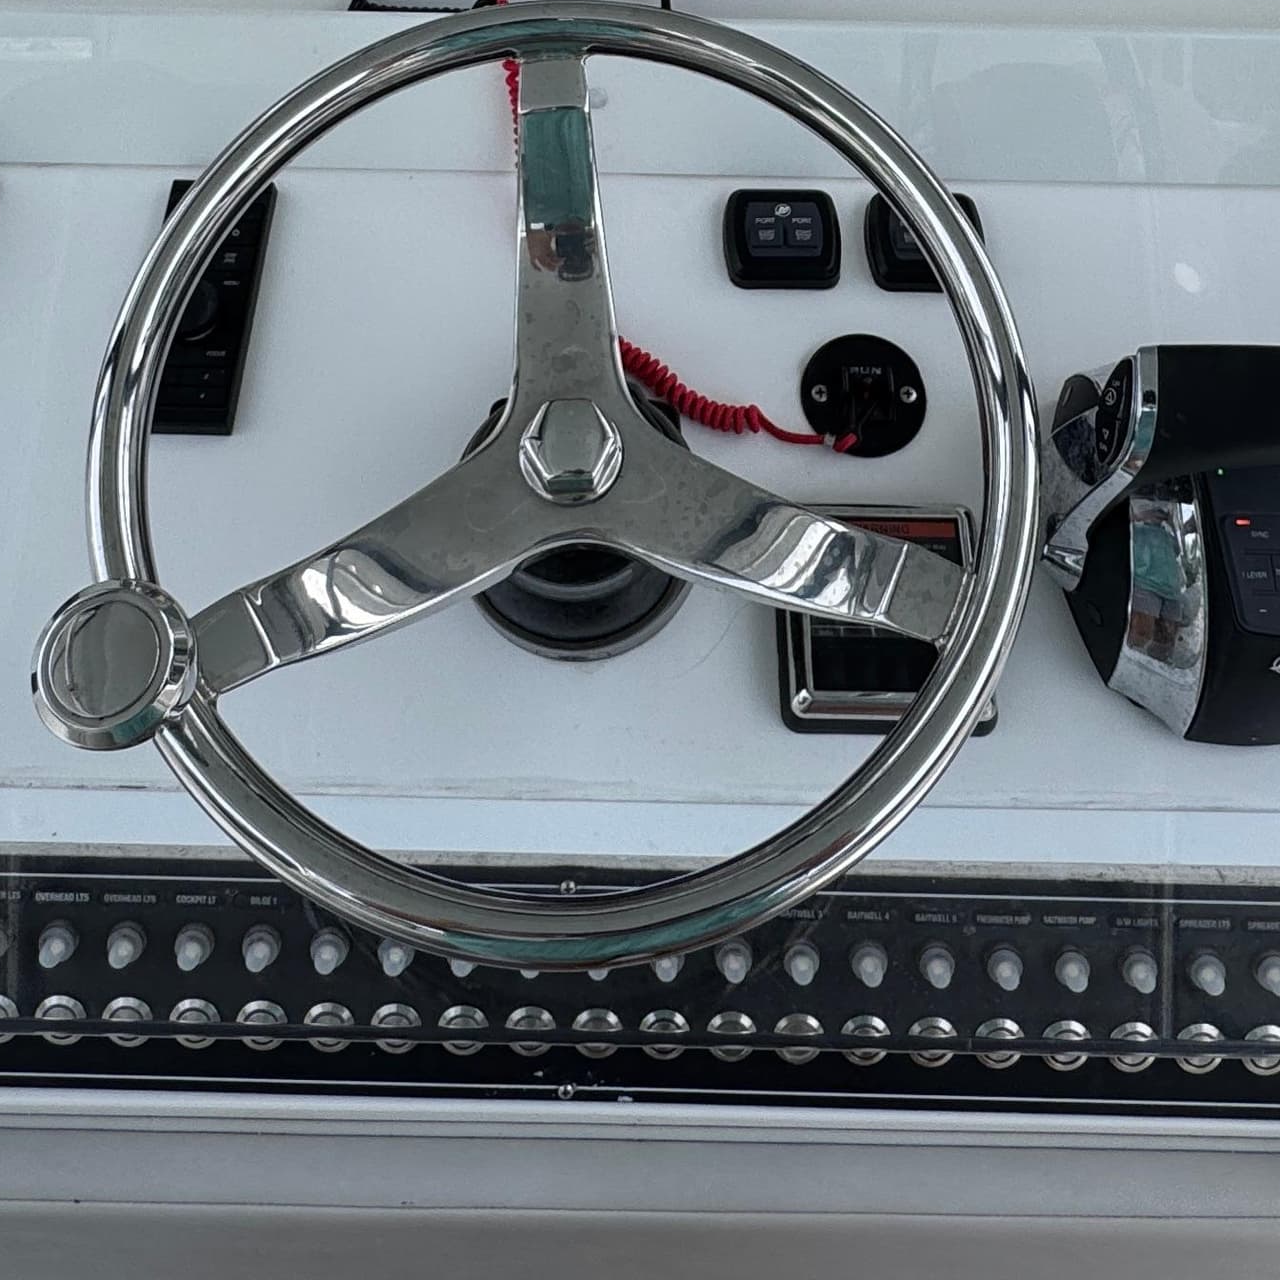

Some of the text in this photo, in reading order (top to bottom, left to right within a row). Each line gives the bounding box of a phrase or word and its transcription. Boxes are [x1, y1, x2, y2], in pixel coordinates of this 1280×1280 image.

[1246, 571, 1268, 579] LEVER
[35, 892, 90, 902] OVERHEAD LTS
[104, 893, 157, 903] OVERHEAD LTS
[176, 894, 217, 904] COCKPIT LT
